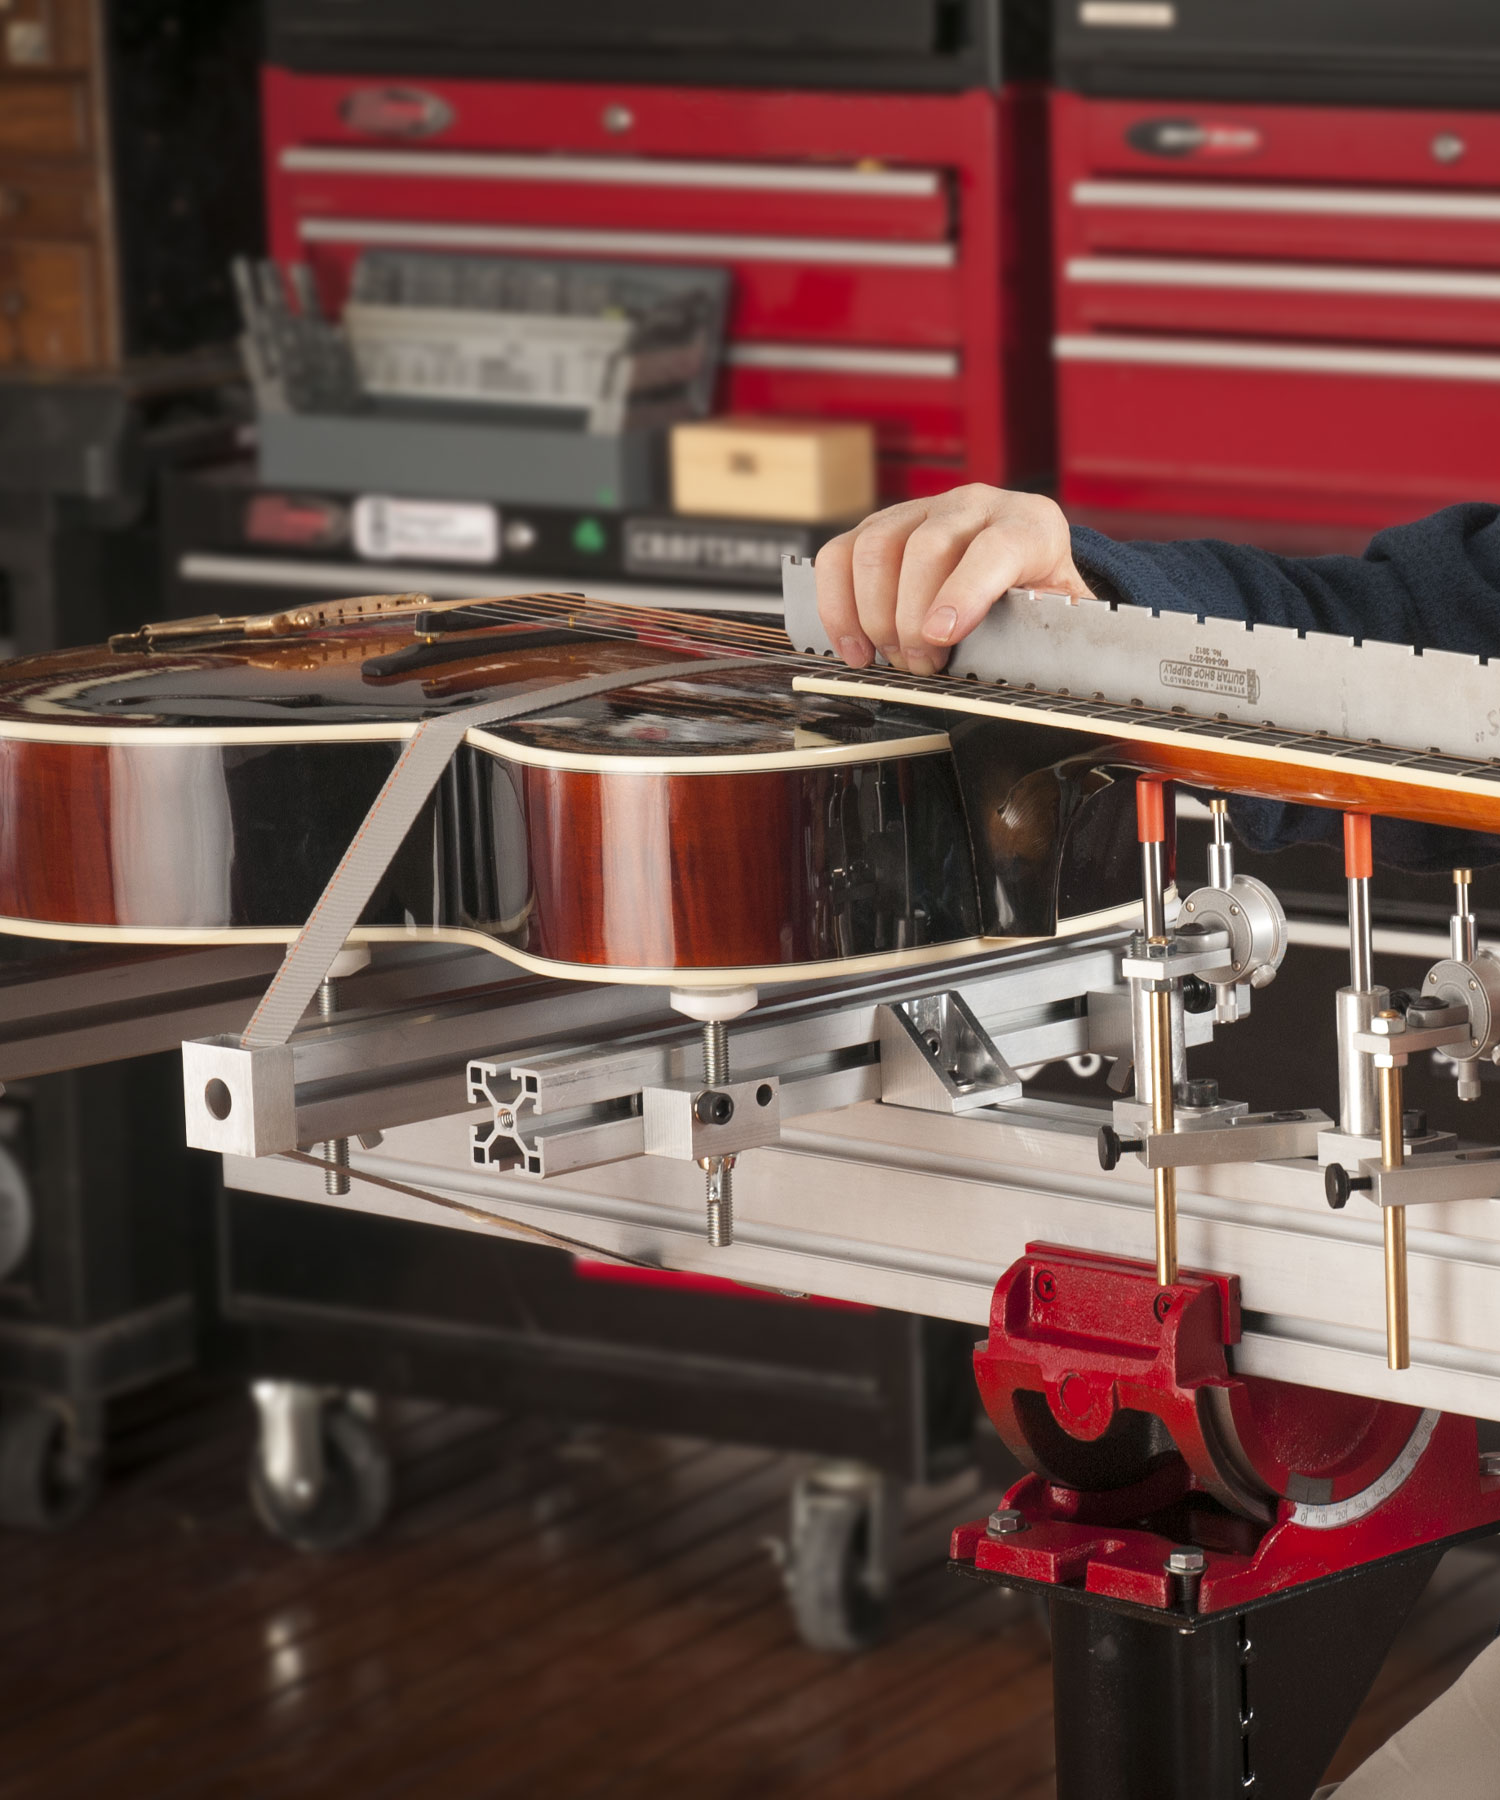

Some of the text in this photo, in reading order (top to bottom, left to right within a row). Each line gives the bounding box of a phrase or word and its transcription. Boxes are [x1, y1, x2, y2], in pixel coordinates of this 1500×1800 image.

[1163, 663, 1246, 686] GUITAR SHOP SUPPLY
